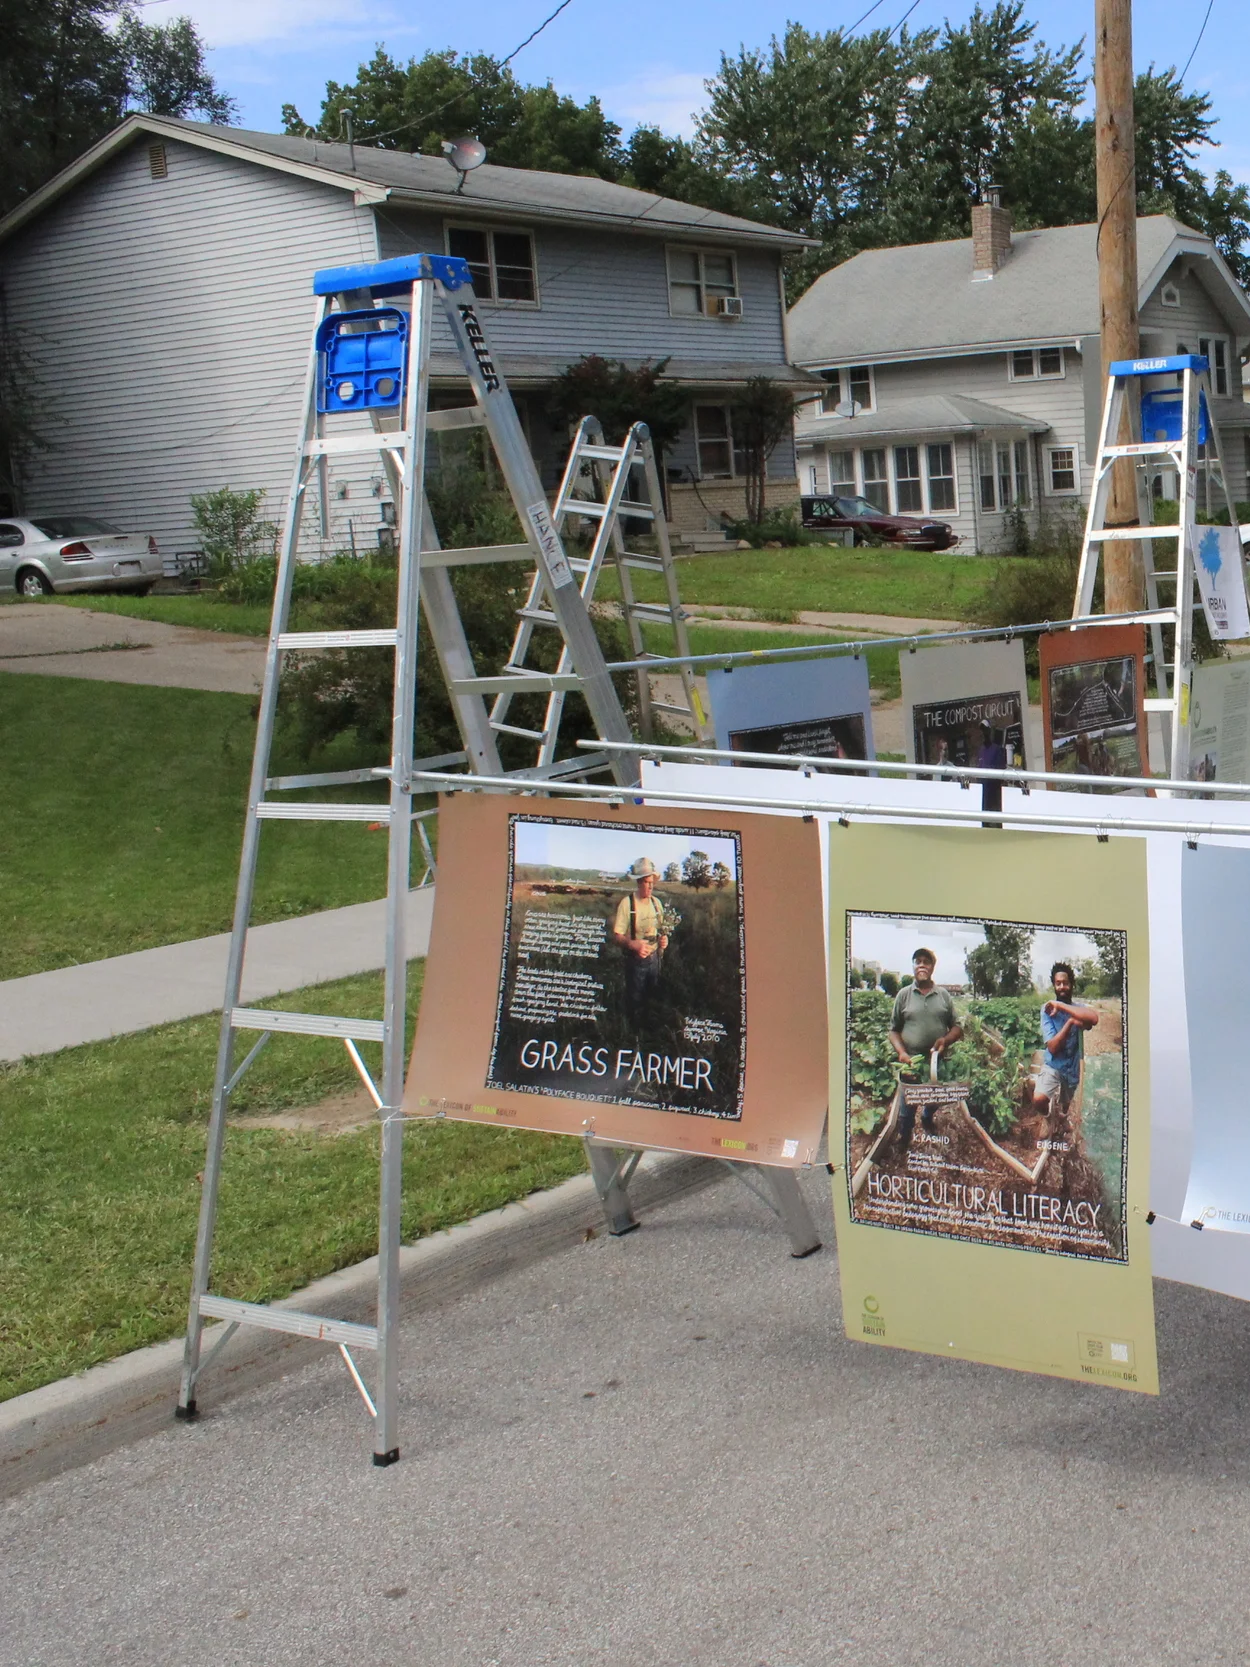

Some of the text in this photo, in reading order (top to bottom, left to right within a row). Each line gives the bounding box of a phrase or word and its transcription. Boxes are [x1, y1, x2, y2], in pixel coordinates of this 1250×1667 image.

[460, 305, 501, 393] KELLER
[1132, 358, 1167, 371] KELLER
[1208, 598, 1226, 610] RBAN
[924, 700, 1014, 728] THE COMPOST CIRCUIT
[702, 1034, 720, 1042] 2010
[521, 1038, 714, 1092] GRASS FARMER
[487, 1080, 504, 1090] JOEL
[506, 1082, 540, 1094] SALATIN'S
[921, 1134, 949, 1144] RASHID
[1036, 1140, 1068, 1151] EUGENE
[868, 1172, 1100, 1228] HORTICULTURAL LITERACY
[1218, 1210, 1231, 1220] THE
[862, 1326, 886, 1336] ABILITY
